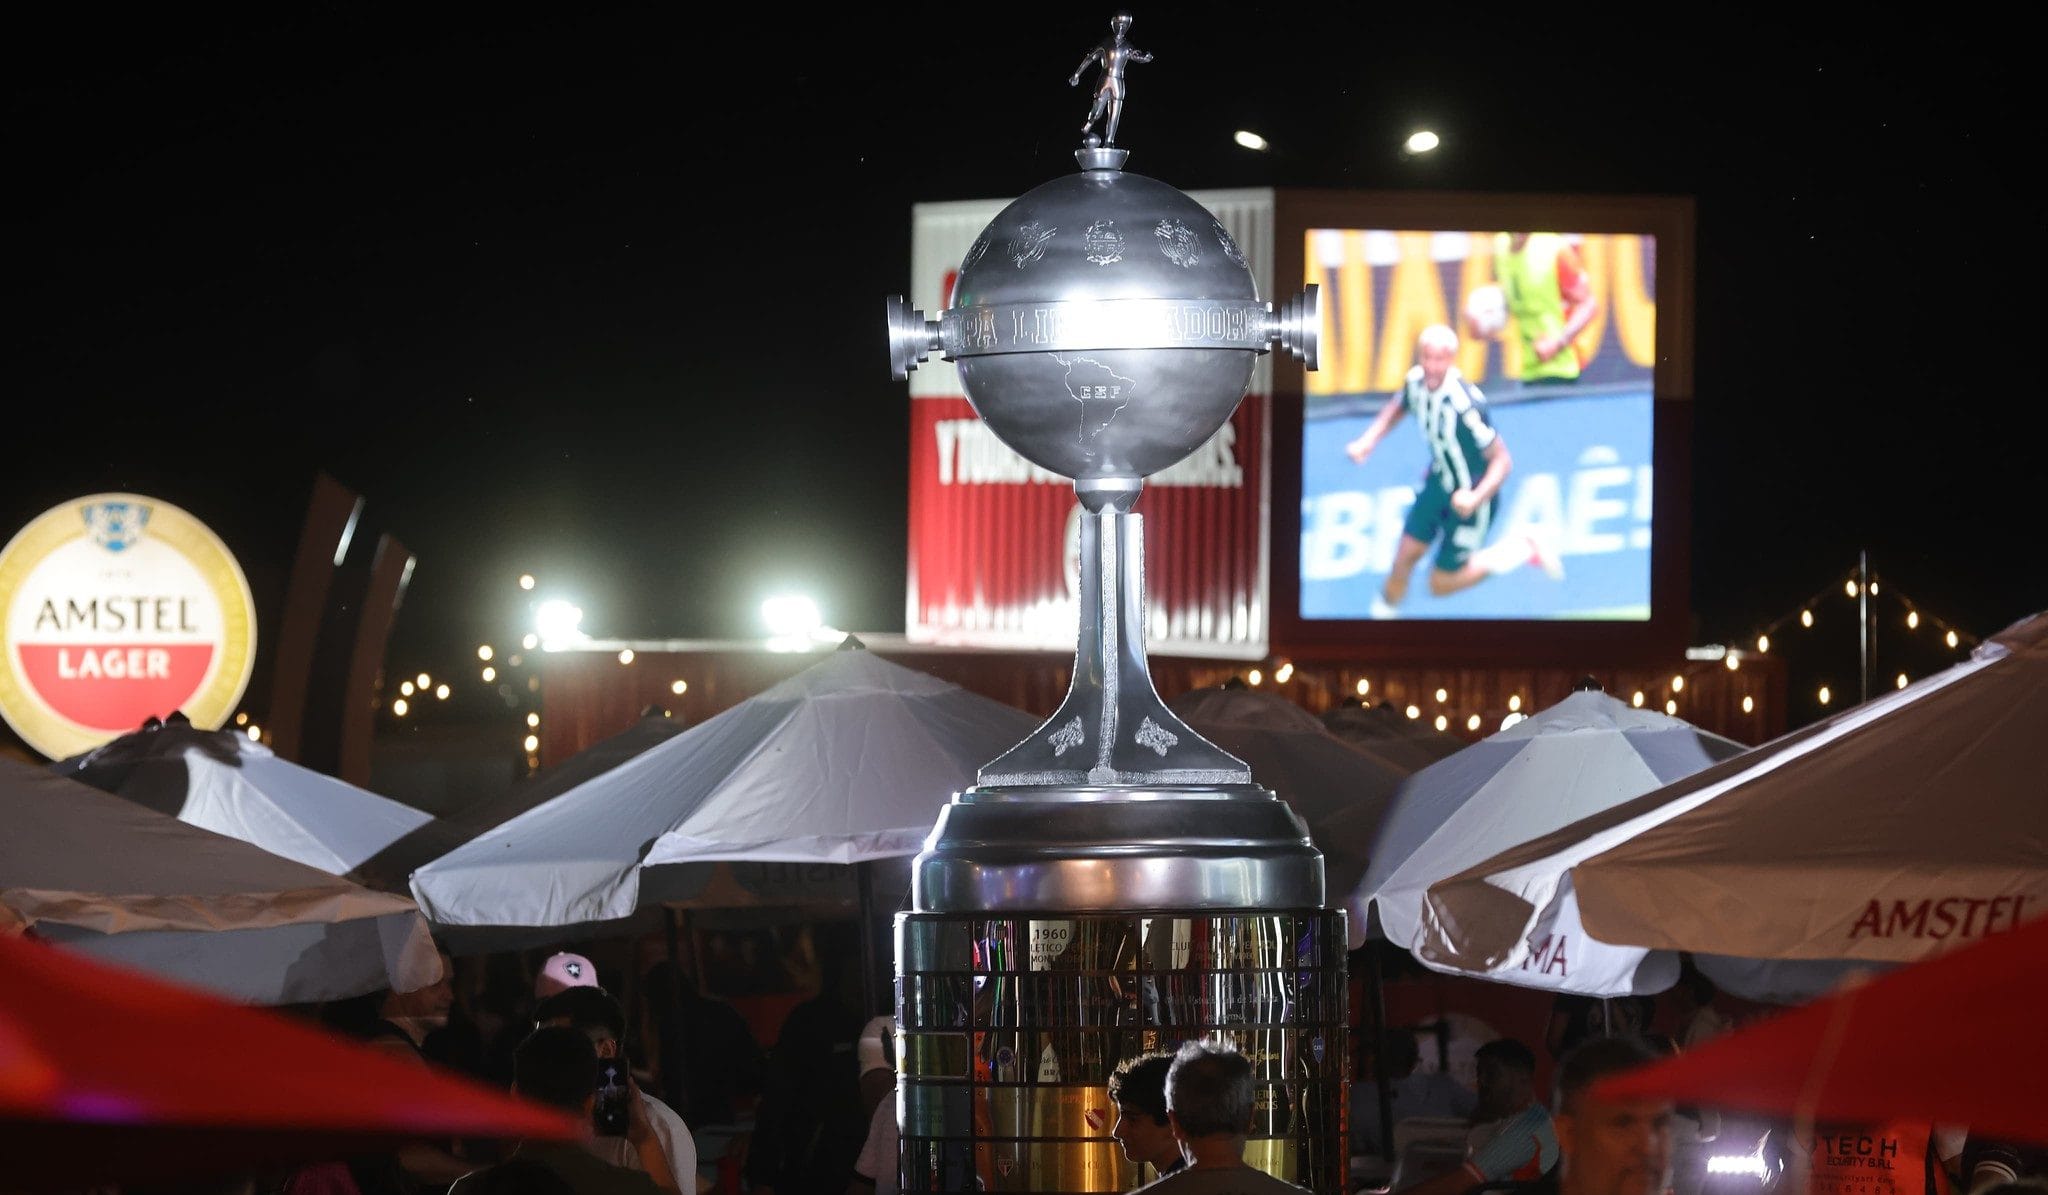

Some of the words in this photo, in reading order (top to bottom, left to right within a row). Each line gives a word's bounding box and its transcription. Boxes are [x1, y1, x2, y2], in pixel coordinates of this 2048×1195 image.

[1012, 305, 1267, 345] LIADORES
[35, 598, 199, 632] AMSTEL
[58, 648, 170, 680] LAGER
[1035, 928, 1068, 940] 1960
[1030, 943, 1063, 952] LETICO
[1824, 1136, 1897, 1157] TECH
